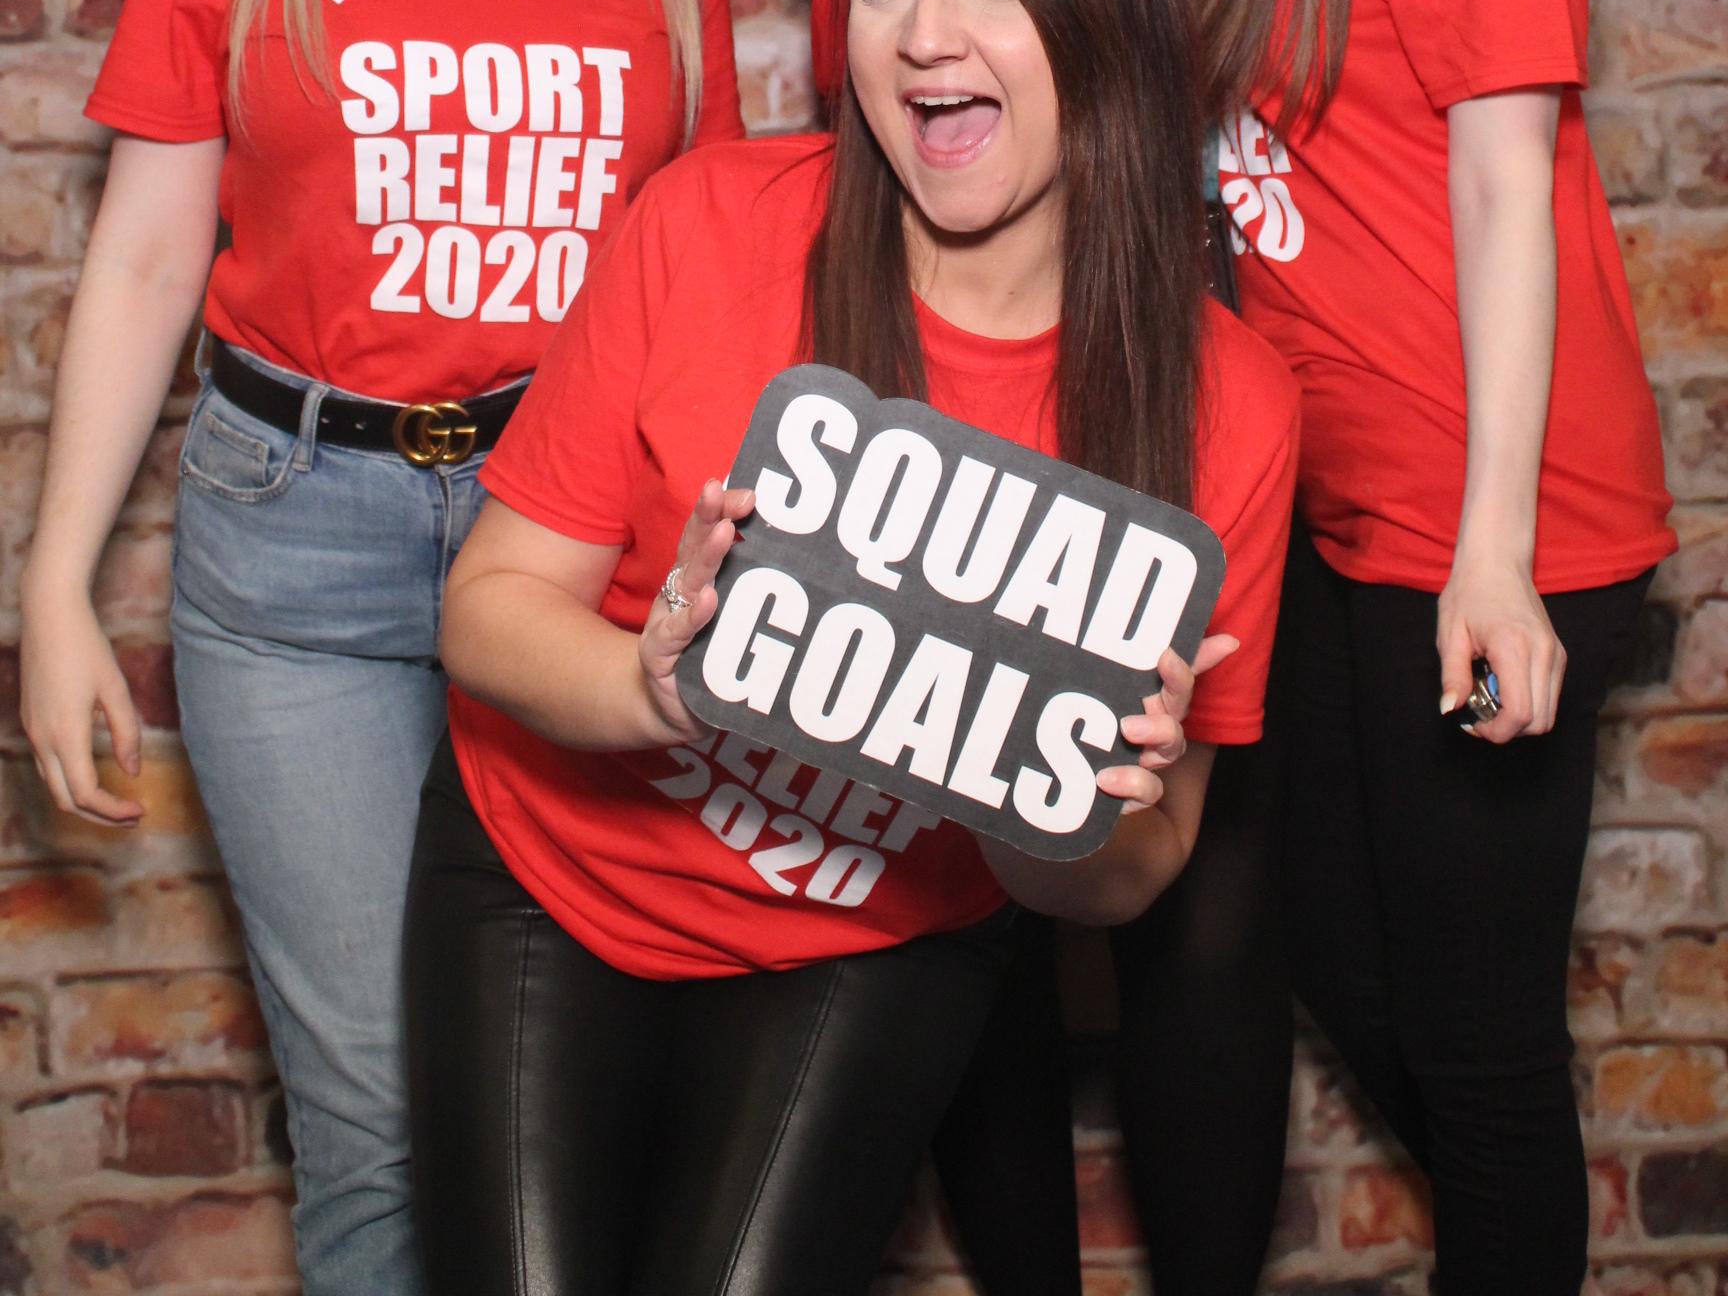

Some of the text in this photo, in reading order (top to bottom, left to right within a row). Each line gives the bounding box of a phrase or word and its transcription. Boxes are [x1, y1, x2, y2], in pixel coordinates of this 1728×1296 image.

[340, 40, 632, 136] SPORT
[353, 133, 624, 230] RELIEF
[370, 222, 589, 323] 2020
[753, 393, 1198, 671] SQUAD
[701, 566, 1118, 834] GOALS
[648, 747, 886, 908] 2020
[684, 730, 942, 854] ELIEF
